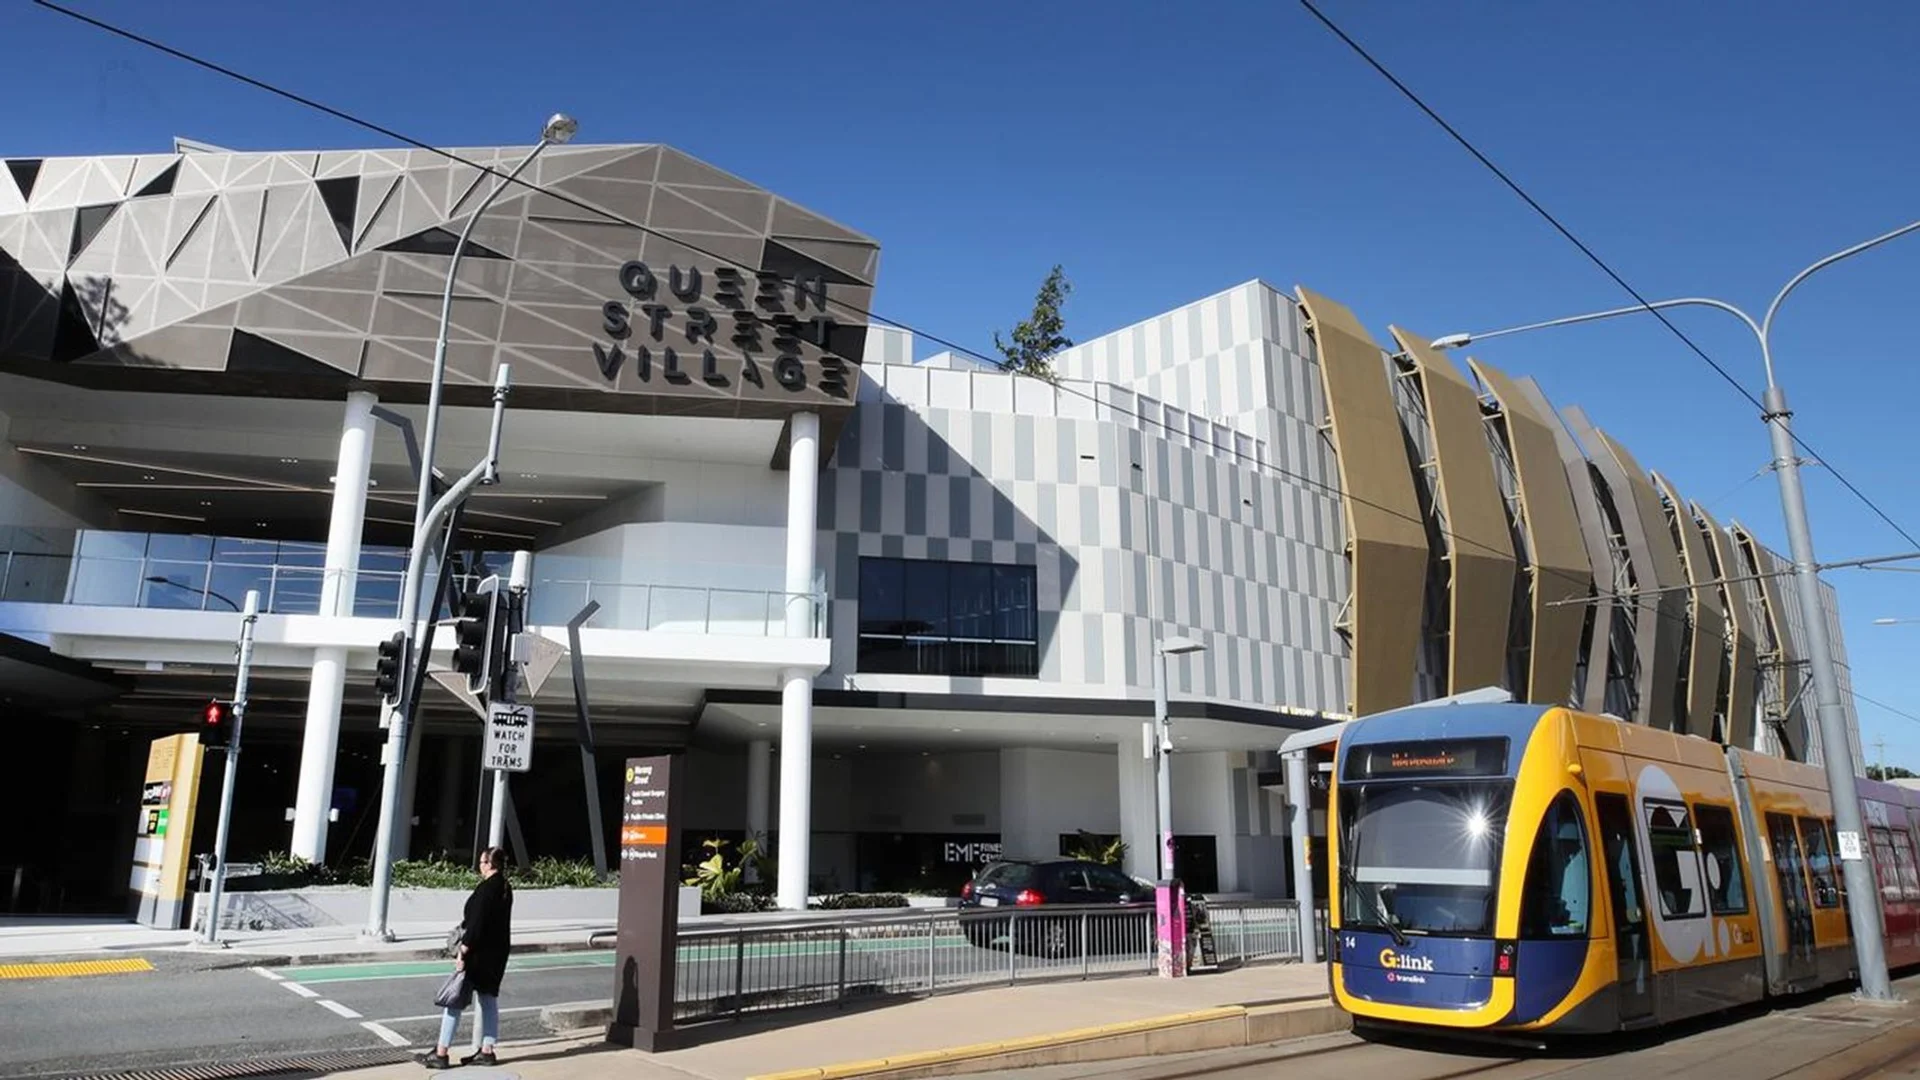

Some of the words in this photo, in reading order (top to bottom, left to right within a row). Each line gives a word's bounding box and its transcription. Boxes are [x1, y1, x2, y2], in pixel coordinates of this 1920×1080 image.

[619, 259, 827, 312] QUEEN
[602, 300, 834, 352] STREET
[592, 342, 850, 397] VILLAGE
[494, 730, 525, 741] WATCH
[499, 742, 517, 754] FOR
[491, 755, 523, 768] TRAMS
[944, 842, 980, 862] EMF
[1345, 936, 1357, 948] 14
[1380, 948, 1435, 972] G:link
